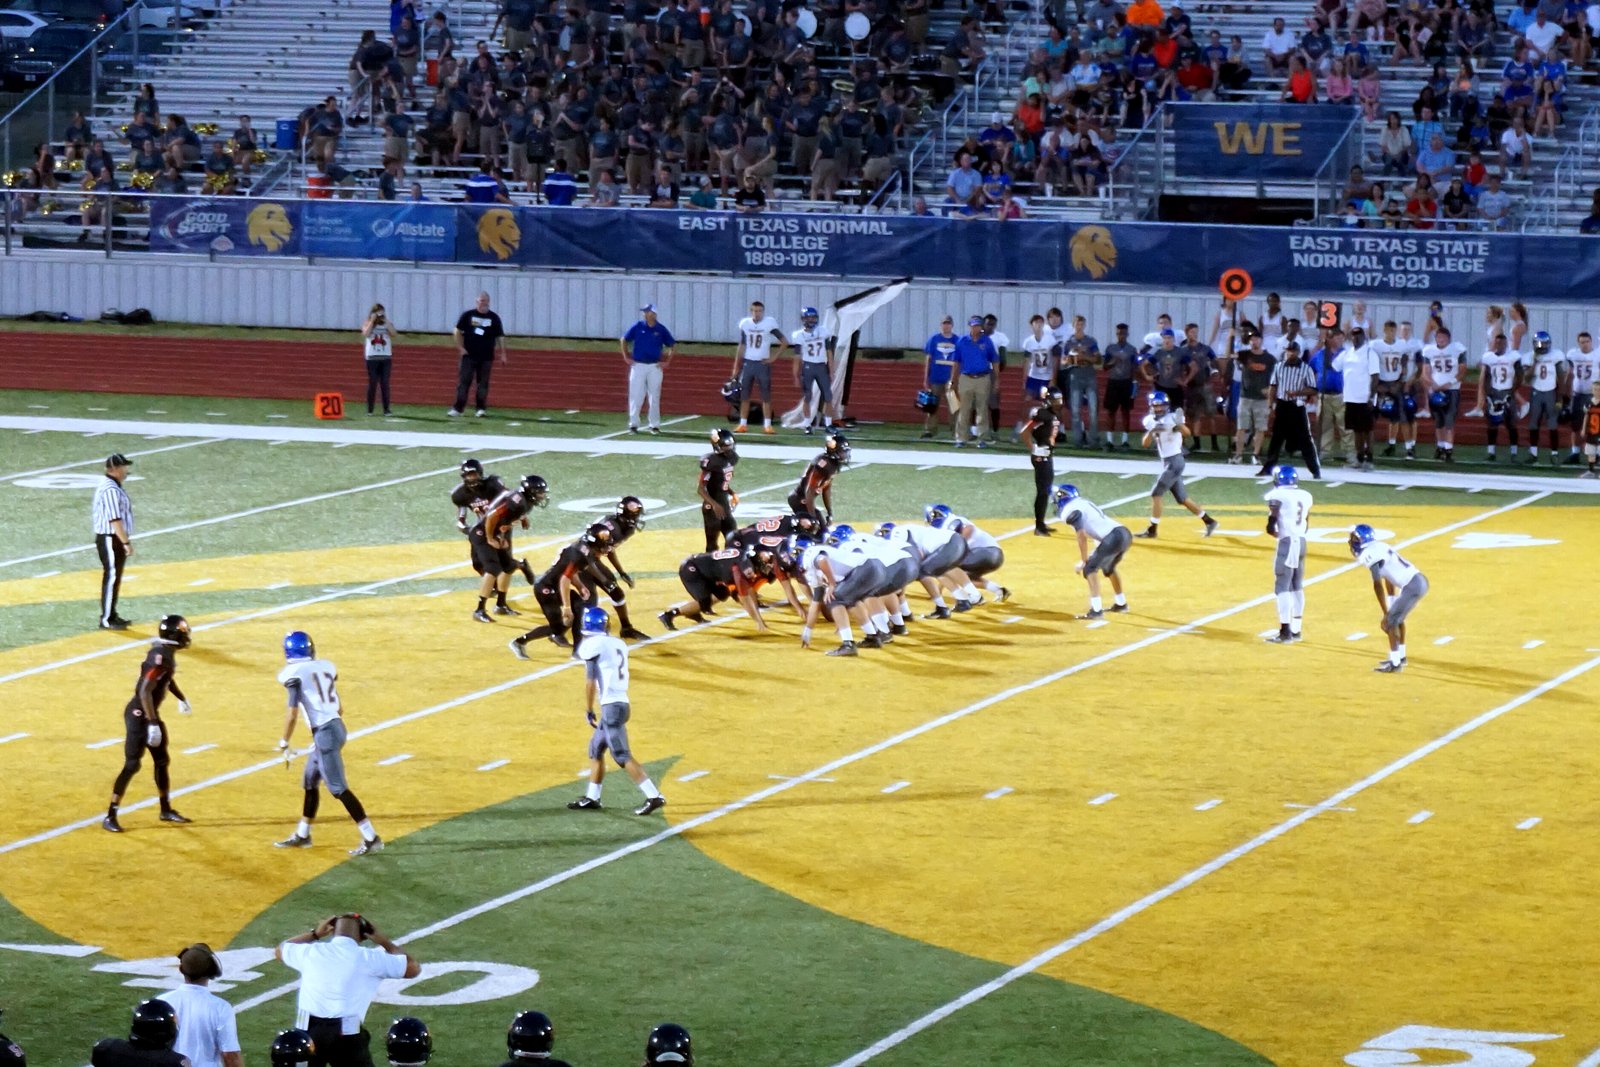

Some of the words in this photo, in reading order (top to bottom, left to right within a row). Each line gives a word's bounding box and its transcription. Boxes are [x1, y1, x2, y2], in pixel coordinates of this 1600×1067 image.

[1214, 122, 1302, 155] WE
[185, 212, 228, 223] GOOD
[678, 216, 730, 230] EAST
[735, 217, 800, 232] TEXAS
[806, 219, 893, 235] NORMAL
[177, 222, 231, 234] SPORT
[394, 222, 446, 237] Allstate
[740, 235, 829, 250] COLLEGE
[1289, 235, 1344, 251] EAST
[1351, 237, 1418, 254] TEXAS
[1425, 238, 1490, 256] STATE
[744, 251, 826, 267] 1889-1917
[1292, 252, 1384, 270] NORMAL
[1390, 255, 1485, 273] COLLEGE
[1346, 272, 1430, 288] 1917-1923
[1320, 303, 1337, 327] 3
[319, 396, 341, 416] 20
[615, 648, 625, 680] 2
[311, 671, 336, 704] 12
